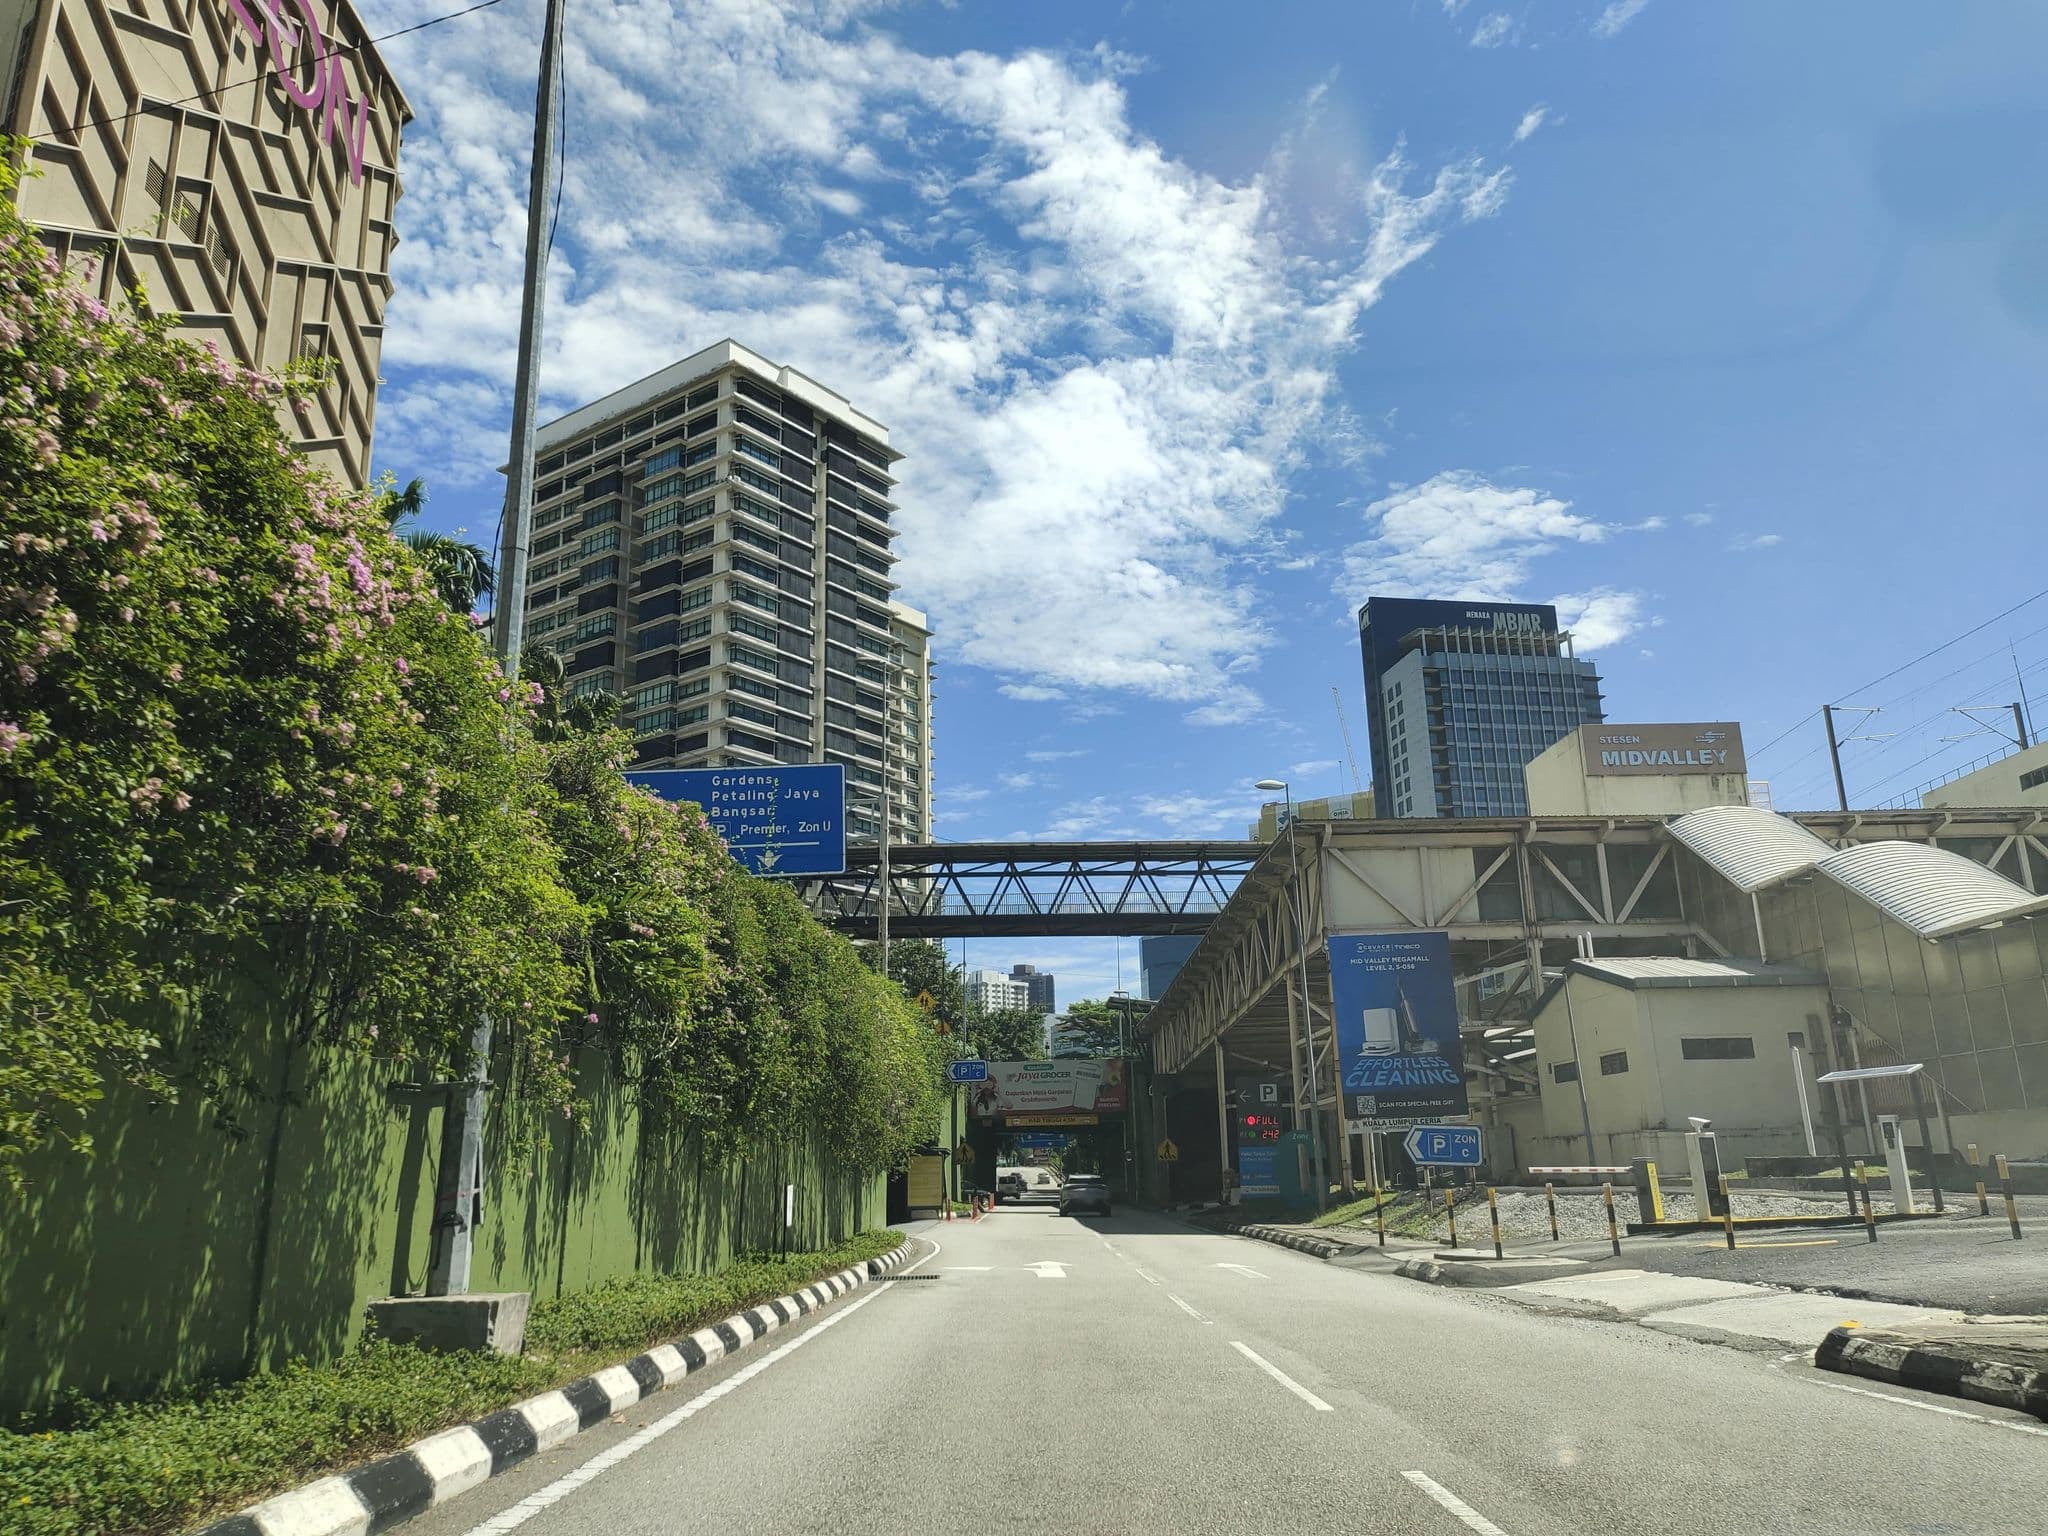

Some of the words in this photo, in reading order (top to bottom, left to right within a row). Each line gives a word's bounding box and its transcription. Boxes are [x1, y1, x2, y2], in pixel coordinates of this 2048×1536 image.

[1493, 612, 1541, 632] MBMR
[1599, 735, 1641, 744] STESEN
[1601, 749, 1728, 767] MIDVALLEY
[711, 789, 775, 802] Petaling
[784, 788, 820, 801] Jaya
[711, 806, 774, 819] Bangsar
[798, 820, 820, 833] Zon
[823, 820, 832, 832] U
[1353, 1056, 1450, 1071] EFFORTLESS
[960, 1066, 968, 1076] P
[1345, 1068, 1460, 1087] CLEANING
[1263, 1086, 1274, 1100] P
[1256, 1115, 1279, 1125] FULL
[1363, 1119, 1387, 1127] KUALA
[1388, 1118, 1419, 1126] LUMPUR
[1420, 1117, 1442, 1125] CERIA
[1262, 1129, 1280, 1140] 242
[1454, 1134, 1476, 1144] ZON
[1433, 1138, 1447, 1154] P
[1461, 1149, 1470, 1158] C
